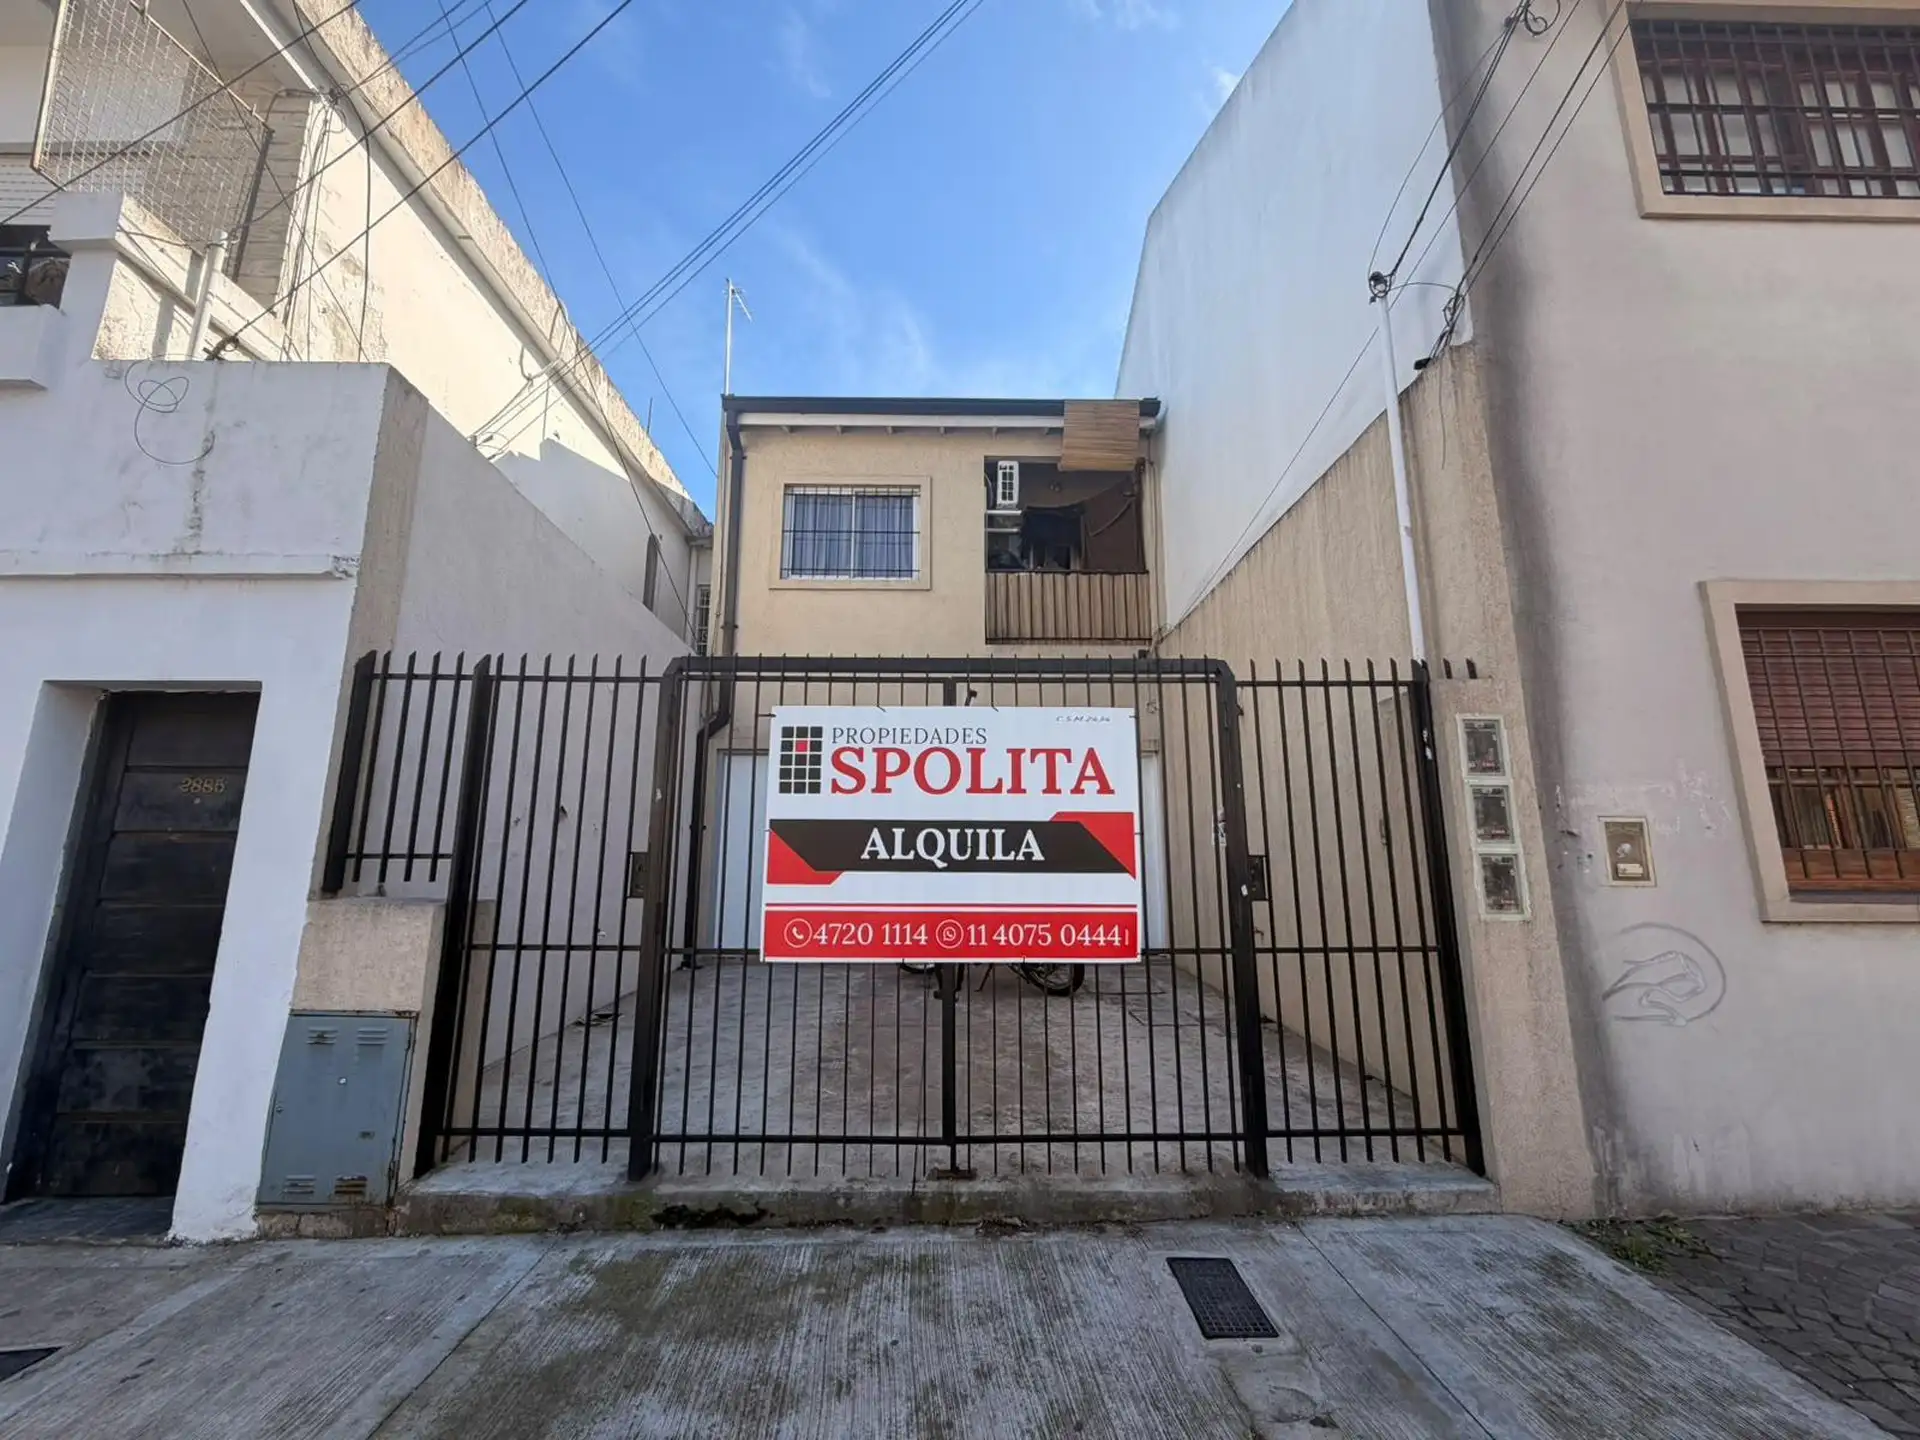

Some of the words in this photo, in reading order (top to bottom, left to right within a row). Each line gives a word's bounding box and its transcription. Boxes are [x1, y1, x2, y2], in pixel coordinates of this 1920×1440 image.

[831, 727, 987, 745] PROPIEDADES
[830, 747, 1115, 795] SPOLITA
[860, 827, 1045, 869] ALQUILA
[813, 923, 873, 945] 4720
[882, 924, 928, 945] 1114
[967, 924, 988, 946] 11
[992, 924, 1052, 946] 4075
